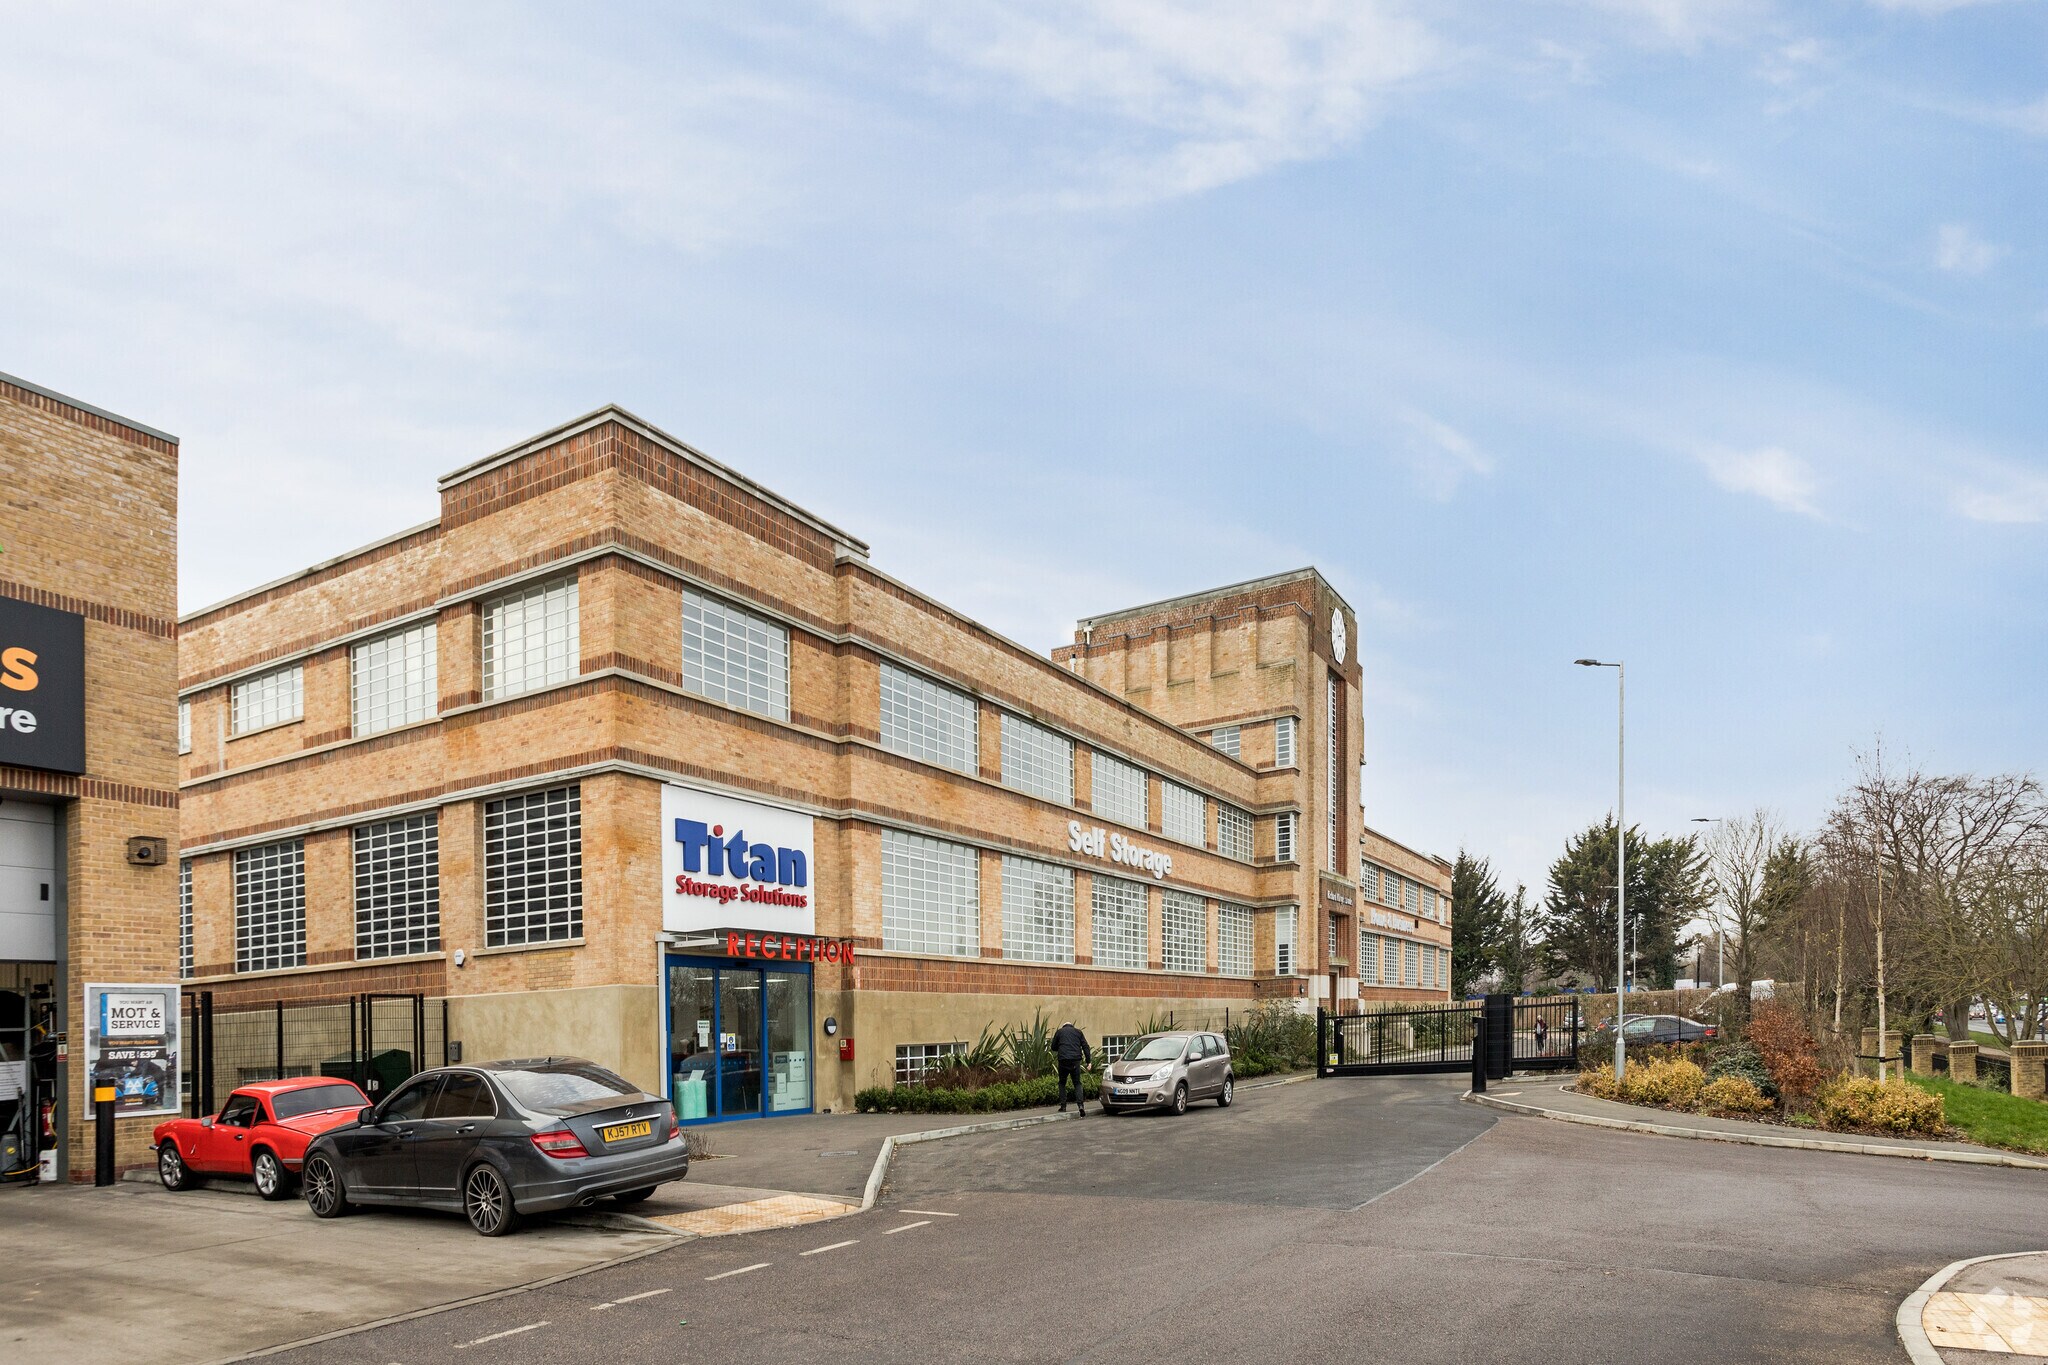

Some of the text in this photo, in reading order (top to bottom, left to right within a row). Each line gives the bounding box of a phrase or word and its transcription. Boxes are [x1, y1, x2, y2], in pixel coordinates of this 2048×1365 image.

[675, 817, 807, 887] Titan
[1068, 820, 1172, 880] Self Storage
[675, 875, 807, 908] Storage Solutions
[727, 931, 855, 964] RECEPTION
[111, 1007, 161, 1018] MOT &
[111, 1020, 161, 1029] SERVICE
[108, 1051, 136, 1060] SAVE
[607, 1122, 647, 1139] KJ57 RTV
